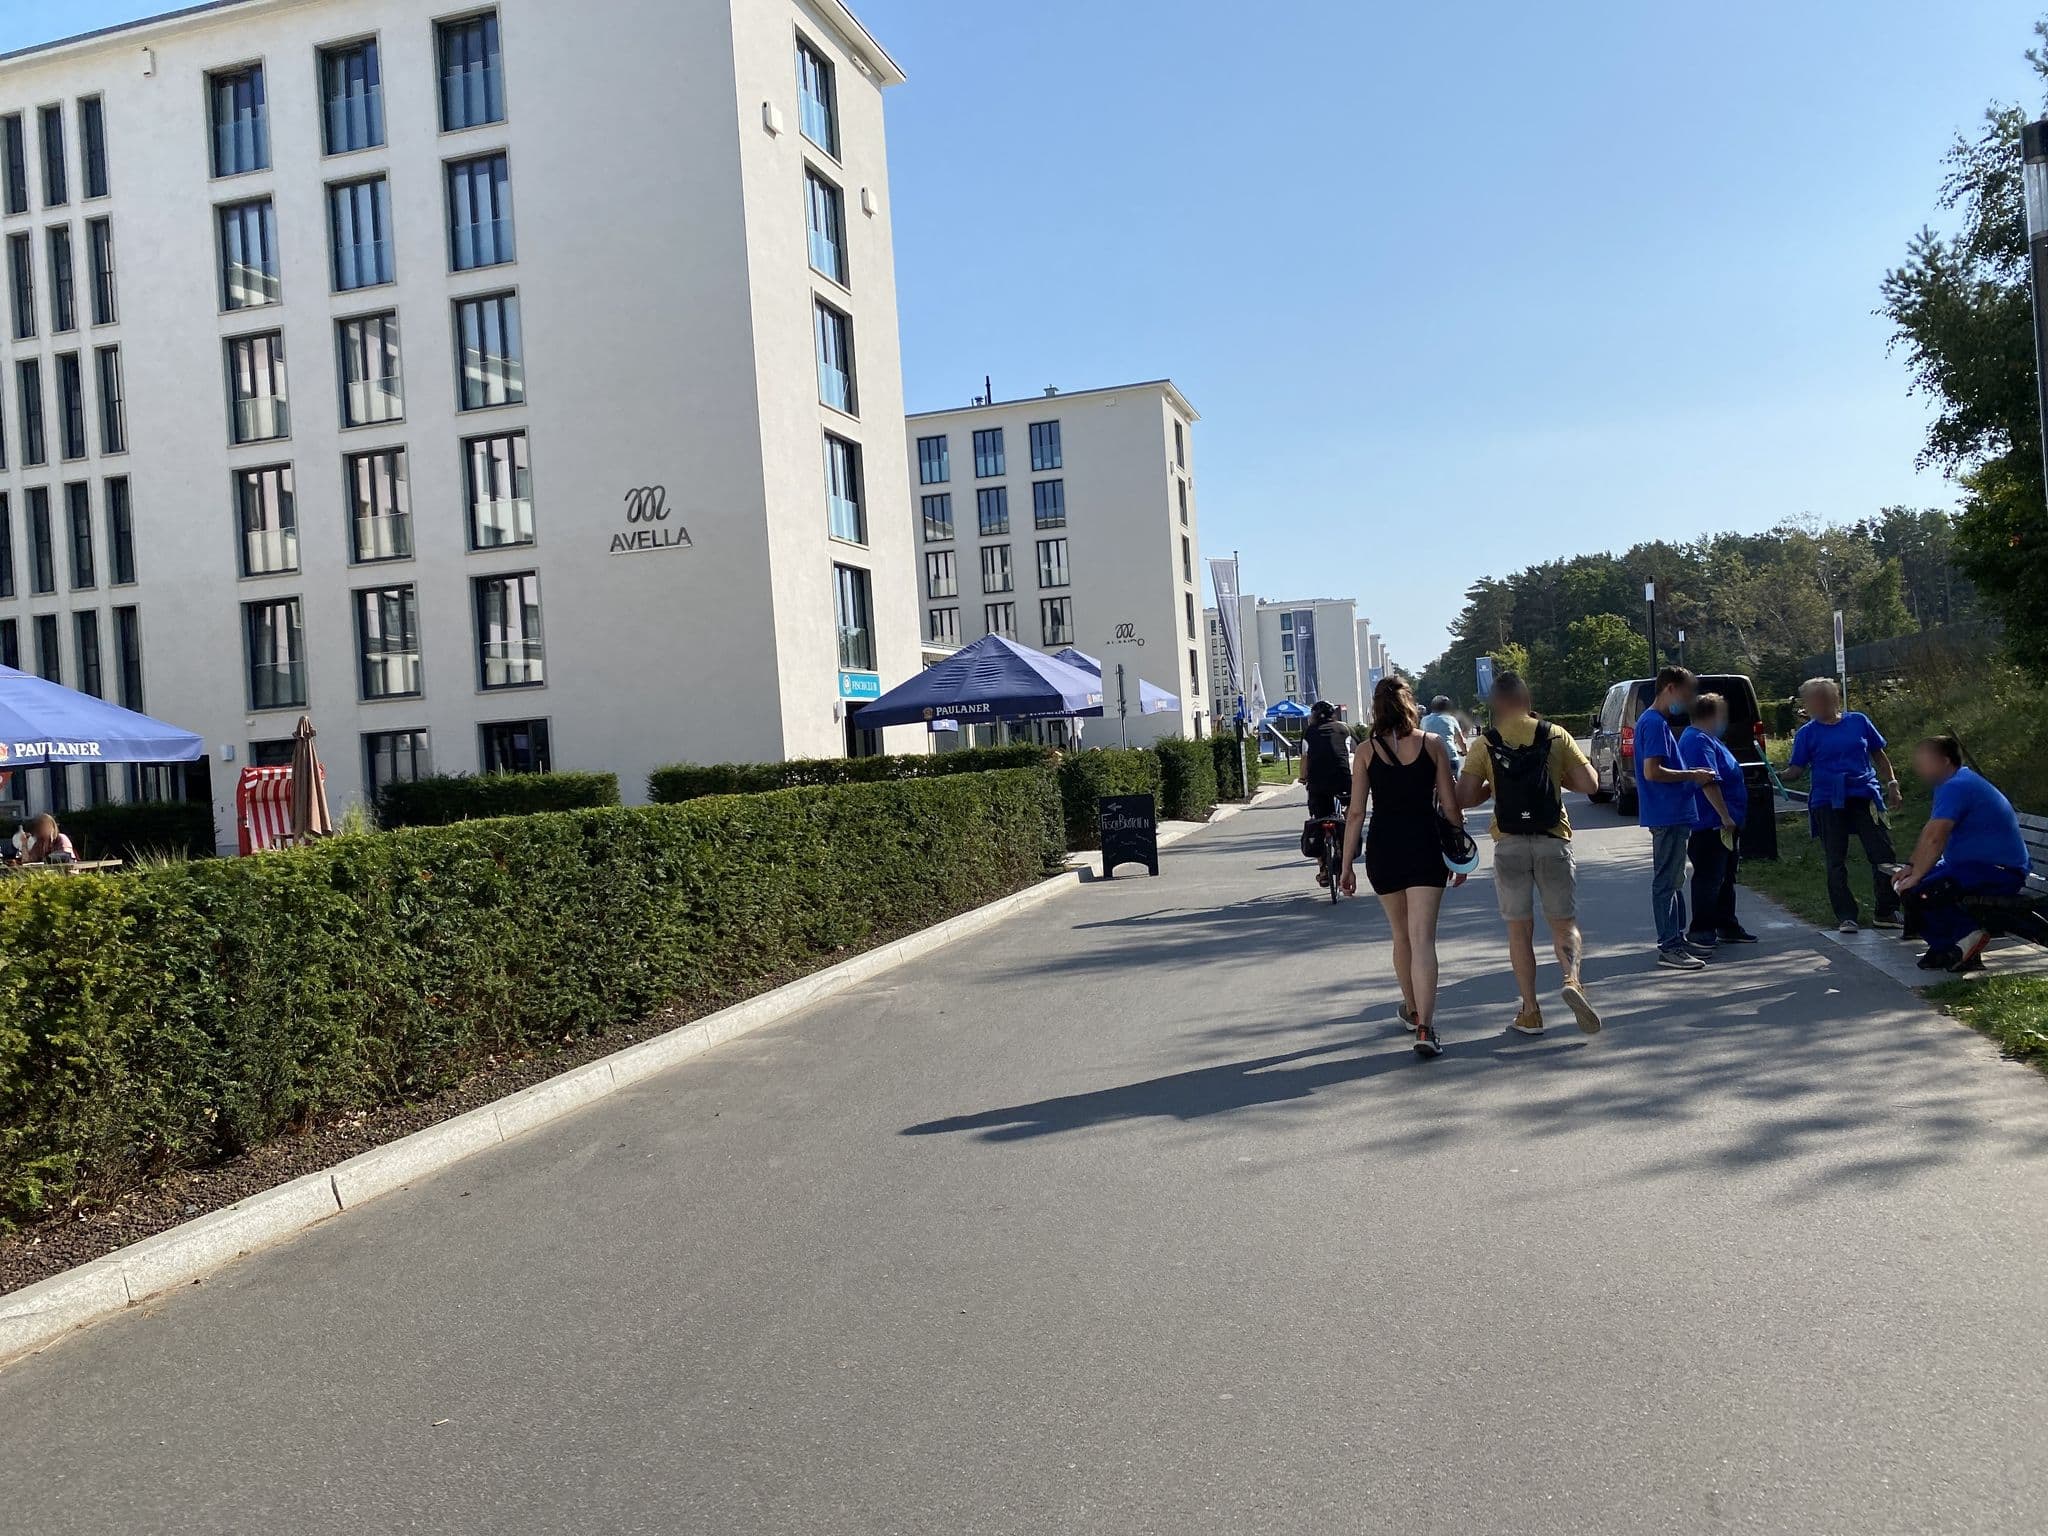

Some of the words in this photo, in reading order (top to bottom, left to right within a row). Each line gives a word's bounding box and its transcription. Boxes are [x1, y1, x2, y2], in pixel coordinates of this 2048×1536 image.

[610, 527, 692, 553] AVELLA
[936, 703, 990, 717] PAULANER
[13, 742, 102, 757] PAULANER
